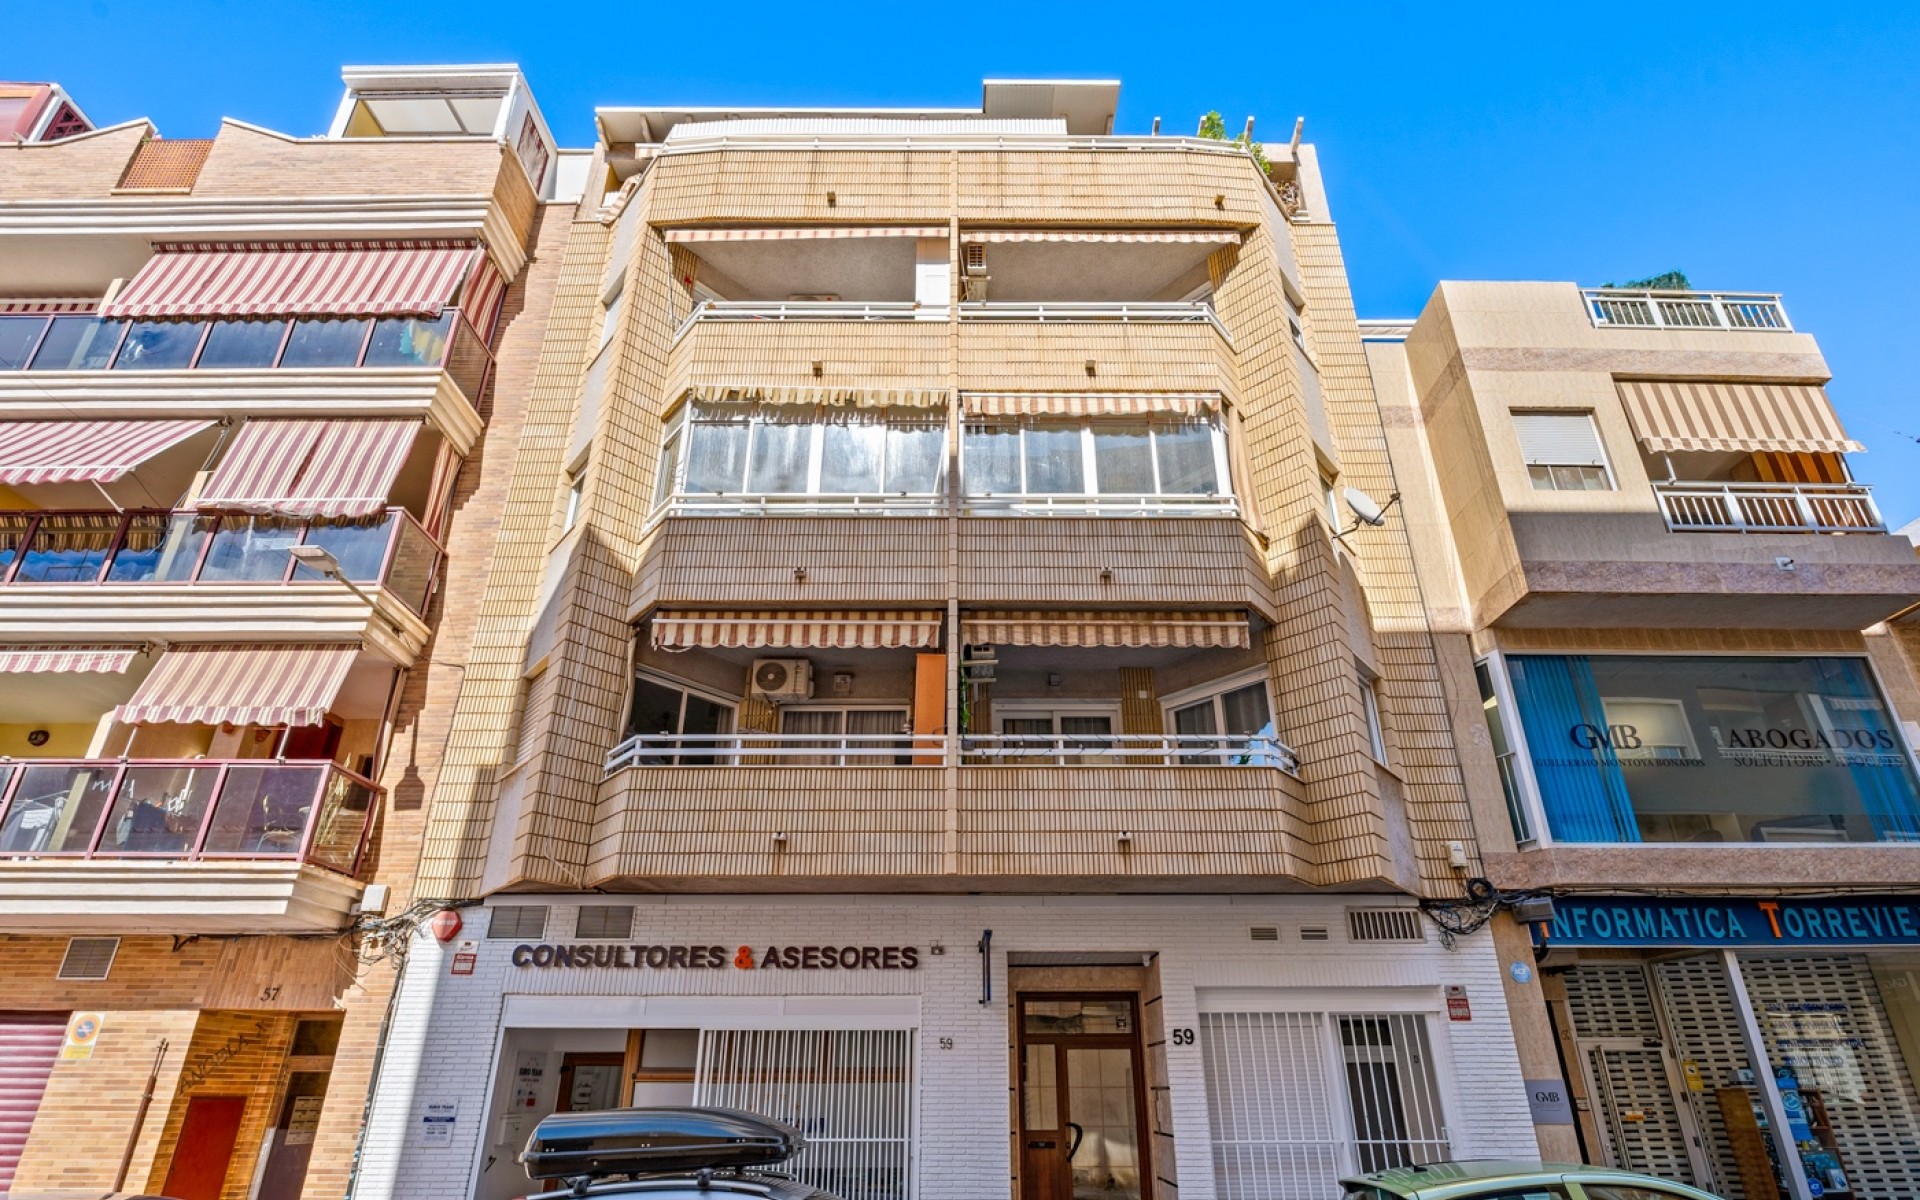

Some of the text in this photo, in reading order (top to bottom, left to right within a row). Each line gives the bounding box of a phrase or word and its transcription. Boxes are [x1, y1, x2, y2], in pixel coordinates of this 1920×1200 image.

[1569, 723, 1895, 750] GMB ABOGADOS
[1535, 757, 1598, 768] GUILLERMO
[1600, 757, 1656, 768] MONTOYA
[1734, 754, 1824, 768] SOLICITORS
[1758, 901, 1920, 938] TORREVIE
[512, 944, 919, 970] CONSULTORES & ASESORES
[260, 986, 282, 1002] 57
[940, 1037, 953, 1050] 59
[1172, 1028, 1195, 1046] 59
[1535, 1091, 1560, 1103] GMB
